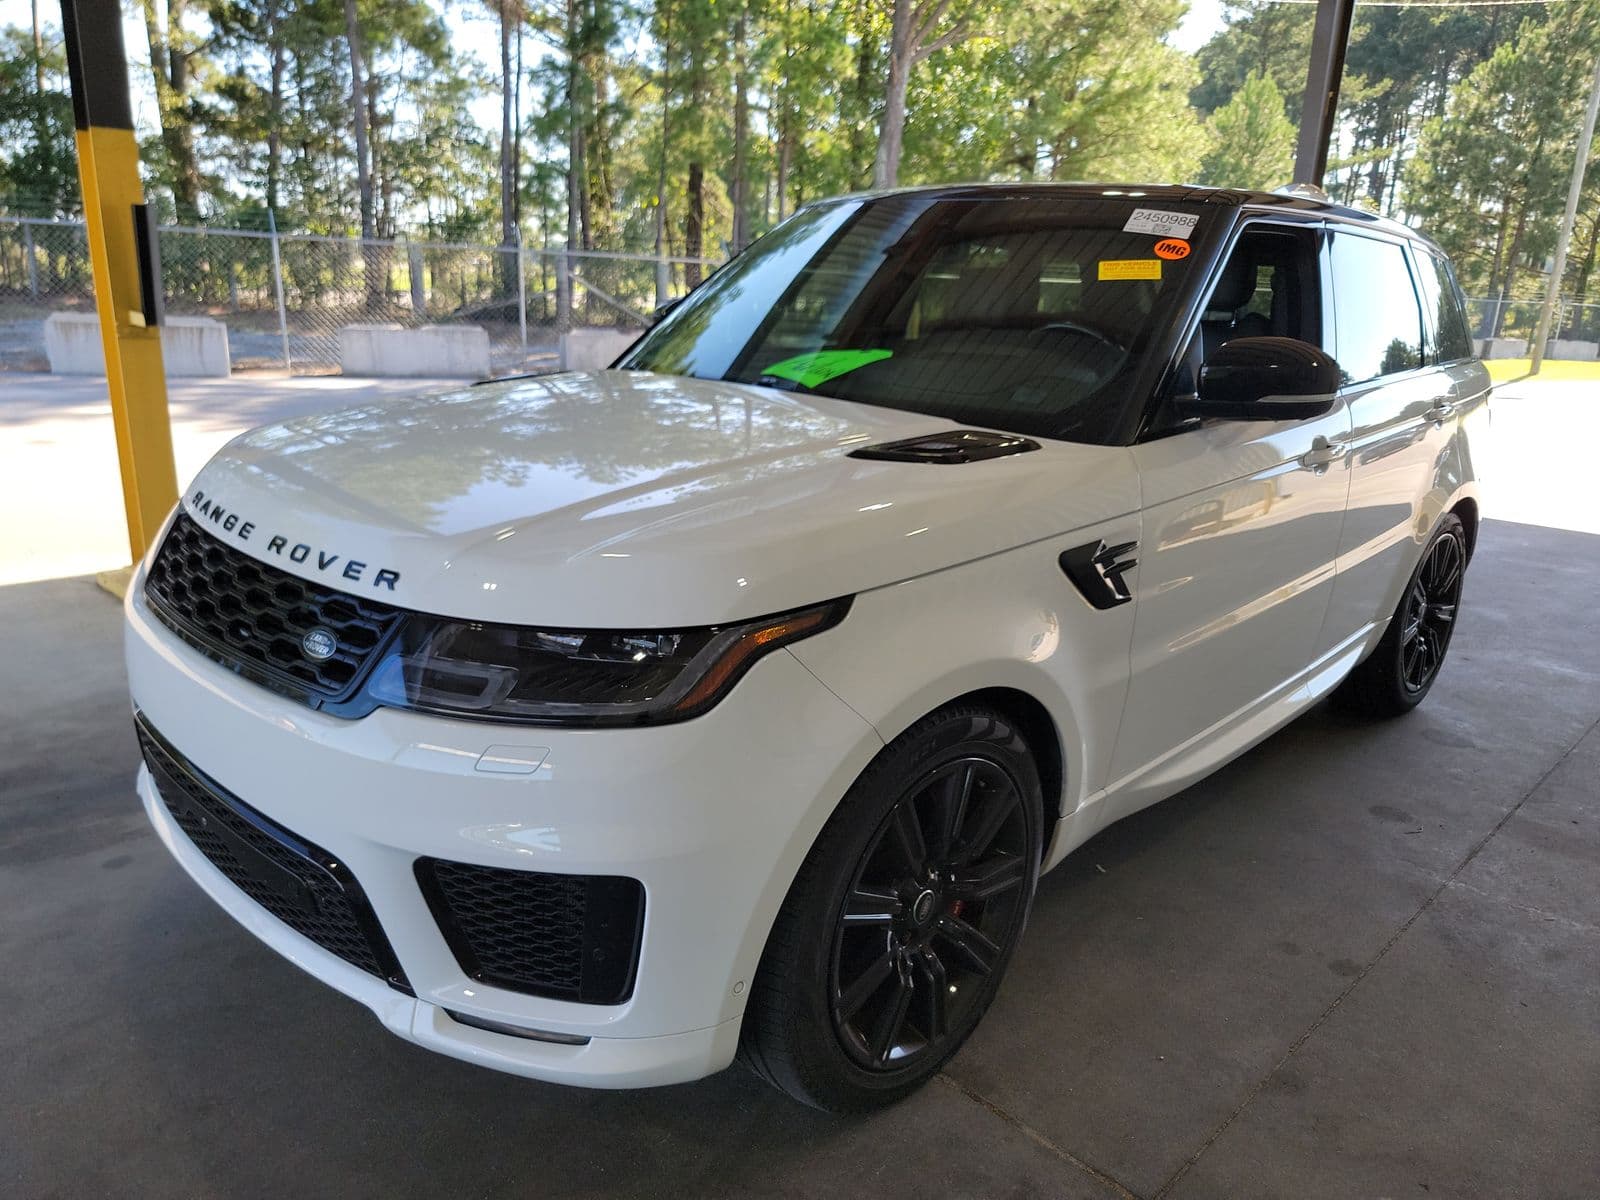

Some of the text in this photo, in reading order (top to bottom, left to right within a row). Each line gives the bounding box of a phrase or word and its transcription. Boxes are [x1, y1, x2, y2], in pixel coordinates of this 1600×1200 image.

[1133, 211, 1198, 228] 2450988
[1158, 242, 1187, 256] IMG
[191, 490, 401, 591] RANGE ROVER
